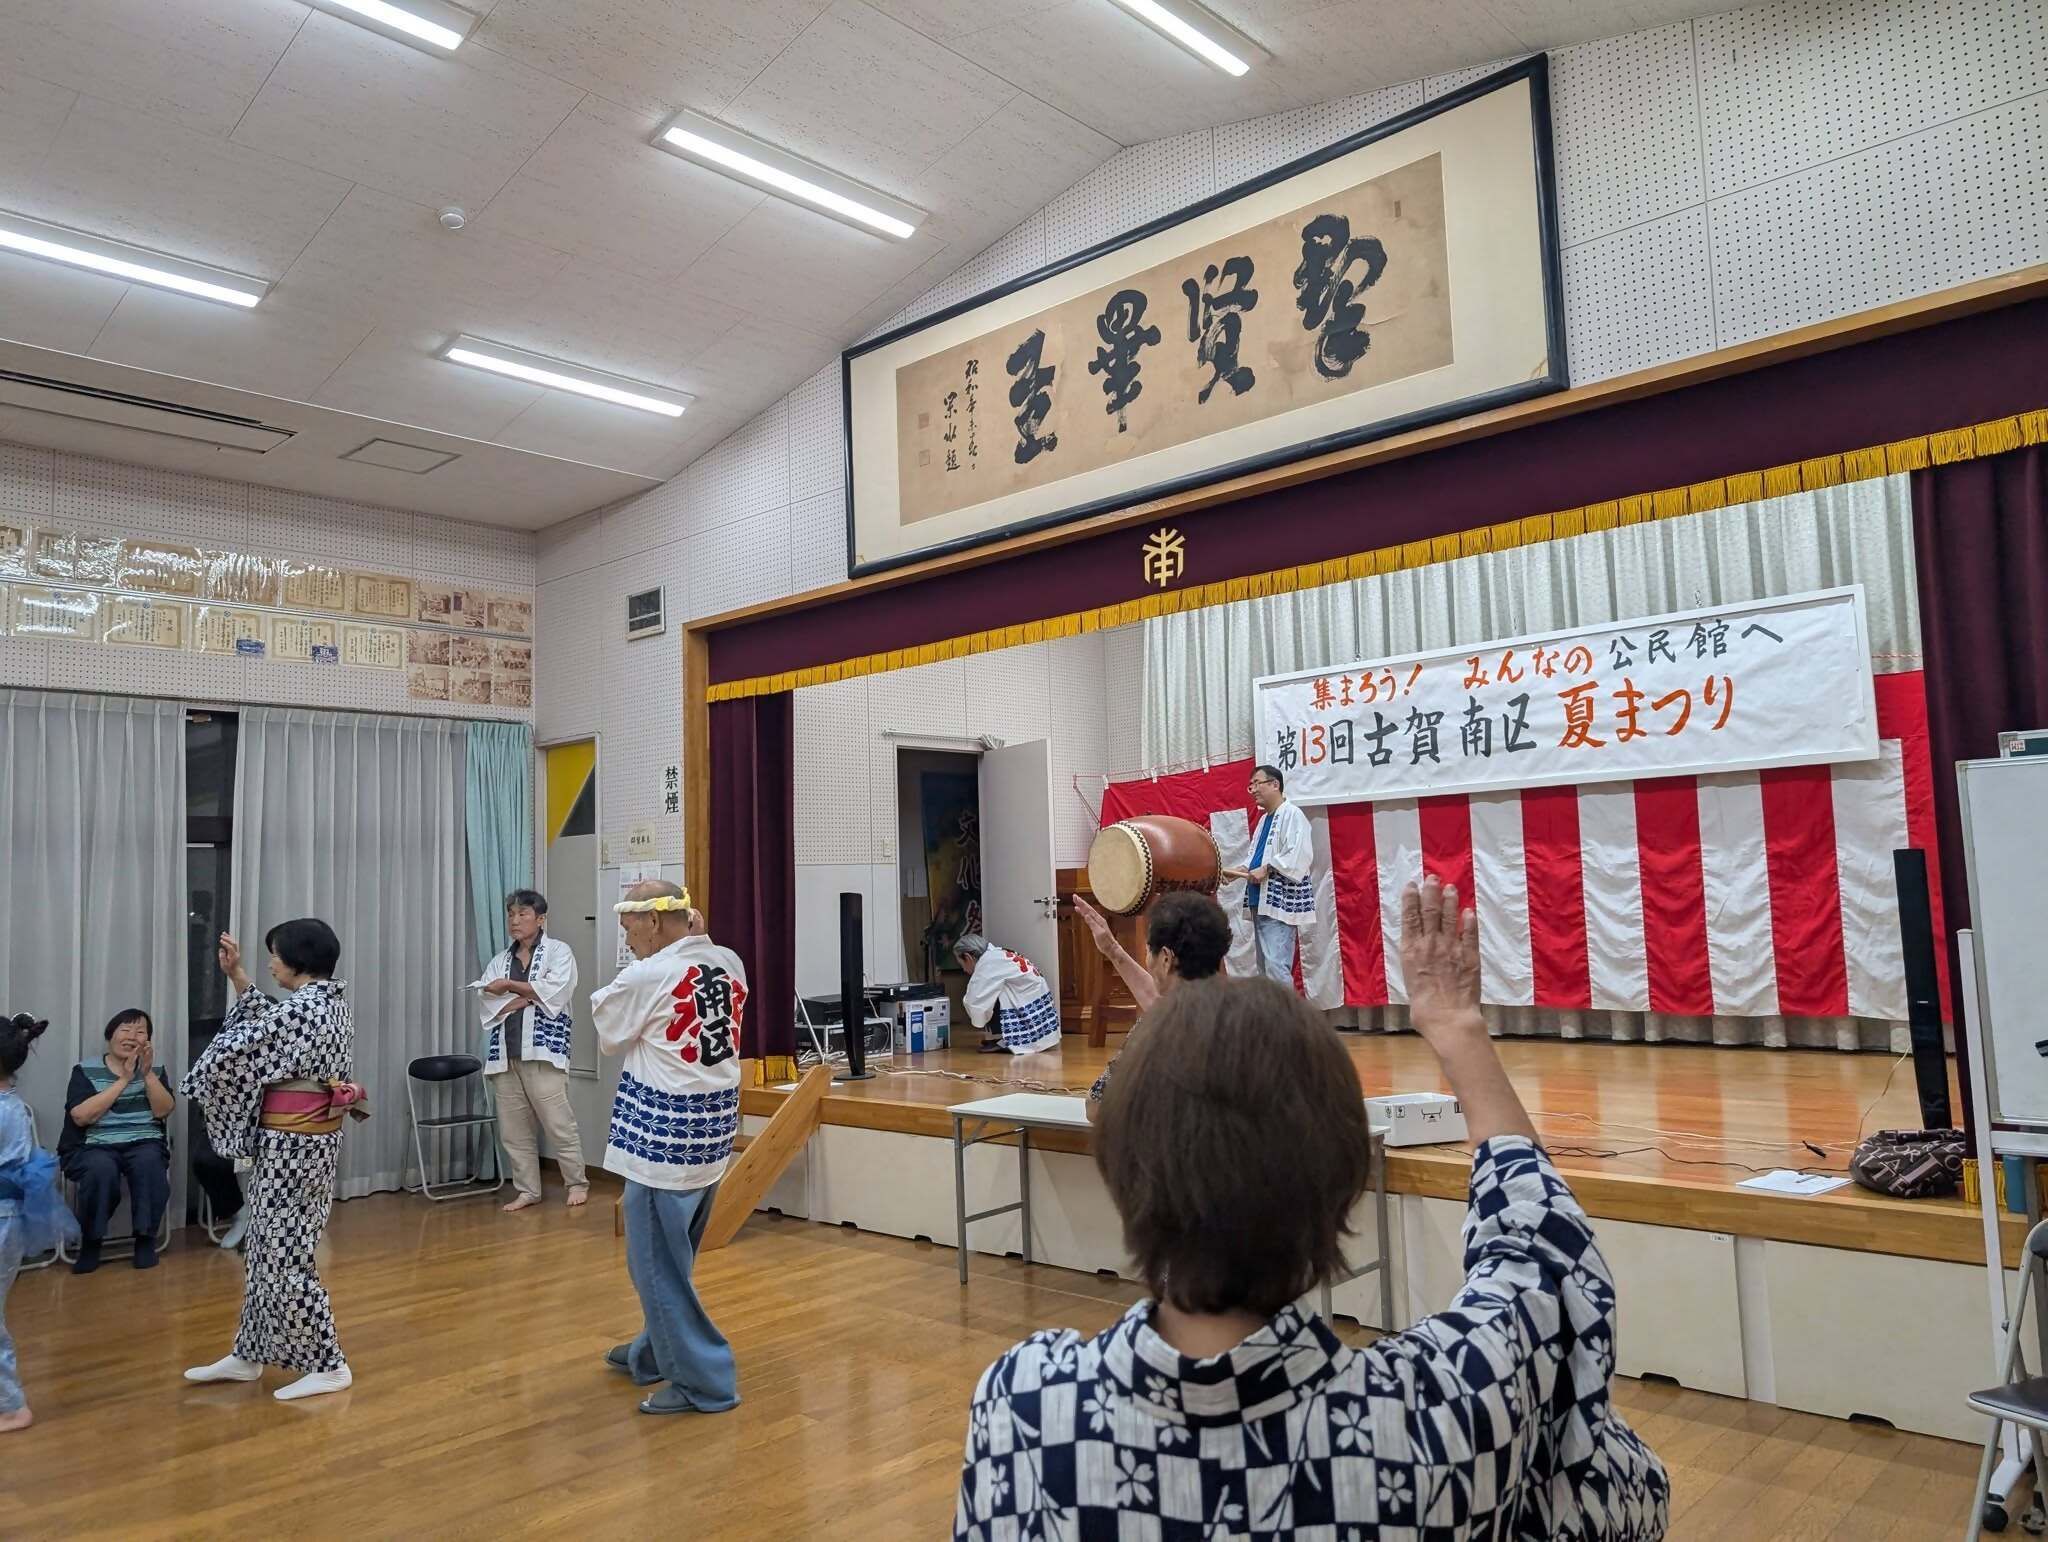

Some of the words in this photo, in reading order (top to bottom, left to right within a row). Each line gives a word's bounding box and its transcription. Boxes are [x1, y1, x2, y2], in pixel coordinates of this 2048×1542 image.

[1310, 663, 1423, 711] 集まろう!
[664, 765, 679, 816] 禁煙
[693, 964, 734, 1067] 南区
